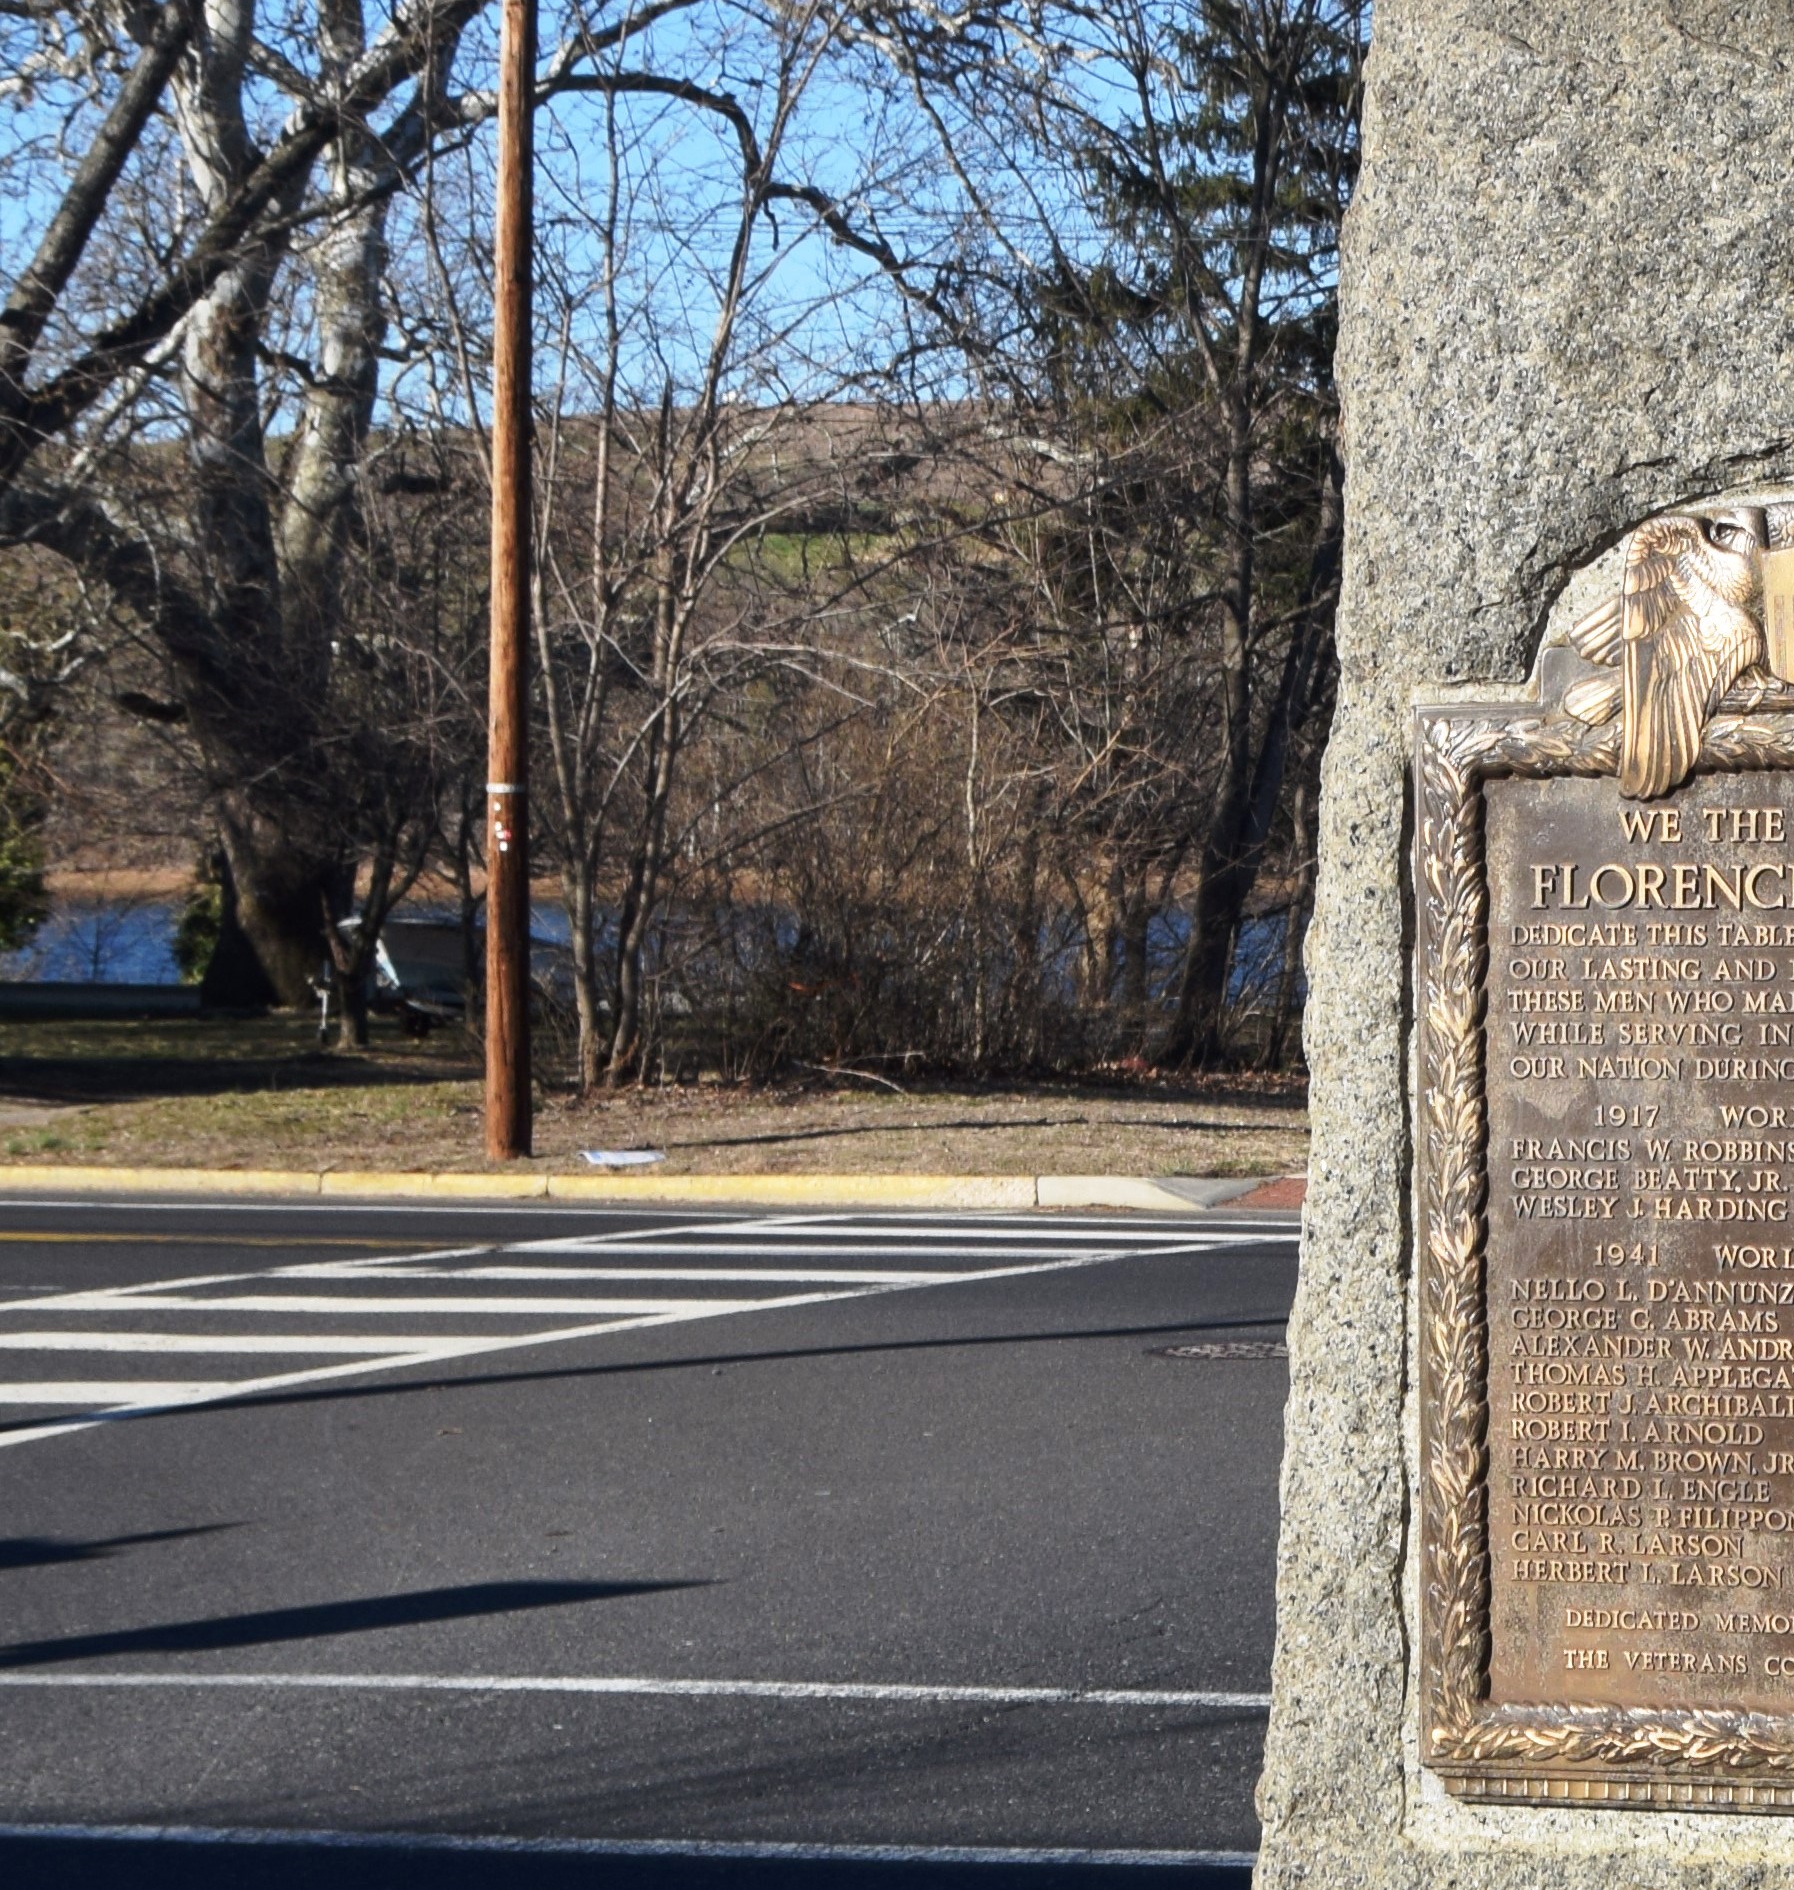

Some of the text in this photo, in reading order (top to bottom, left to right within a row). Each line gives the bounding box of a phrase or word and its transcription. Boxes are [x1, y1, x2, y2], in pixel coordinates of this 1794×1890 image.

[1619, 809, 1683, 842] WE
[1704, 808, 1786, 842] THE
[1510, 924, 1638, 947] DEDICATE
[1647, 924, 1708, 947] THIS
[1509, 959, 1566, 980] OUR
[1582, 959, 1701, 981] LASTING
[1713, 959, 1776, 981] AND
[1507, 991, 1585, 1011] THESE
[1595, 991, 1655, 1012] MEN
[1666, 992, 1734, 1012] WHO
[1510, 1022, 1604, 1045] WHILE
[1619, 1023, 1743, 1045] SERVING
[1759, 1023, 1793, 1045] IN
[1510, 1057, 1566, 1079] OUR
[1578, 1058, 1683, 1080] NATION
[1594, 1105, 1660, 1128] 1917
[1510, 1196, 1788, 1222] WESLEY J. HARDING
[1594, 1243, 1660, 1266] 1941
[1510, 1280, 1606, 1301] NELLO
[1616, 1281, 1638, 1301] L.
[1510, 1336, 1673, 1358] ALEXANDER
[1683, 1339, 1709, 1359] W.
[1510, 1362, 1627, 1386] THOMAS
[1638, 1365, 1661, 1388] H.
[1510, 1418, 1764, 1445] ROBERT I. ARNOLD
[1510, 1476, 1771, 1503] RICHARD L. ENGLE
[1511, 1531, 1743, 1558] CARL R. LARSON
[1510, 1560, 1784, 1589] HERBERT L. LARSON
[1566, 1609, 1699, 1631] DEDICATED
[1564, 1649, 1609, 1669] THE
[1624, 1651, 1748, 1673] VETERANS
